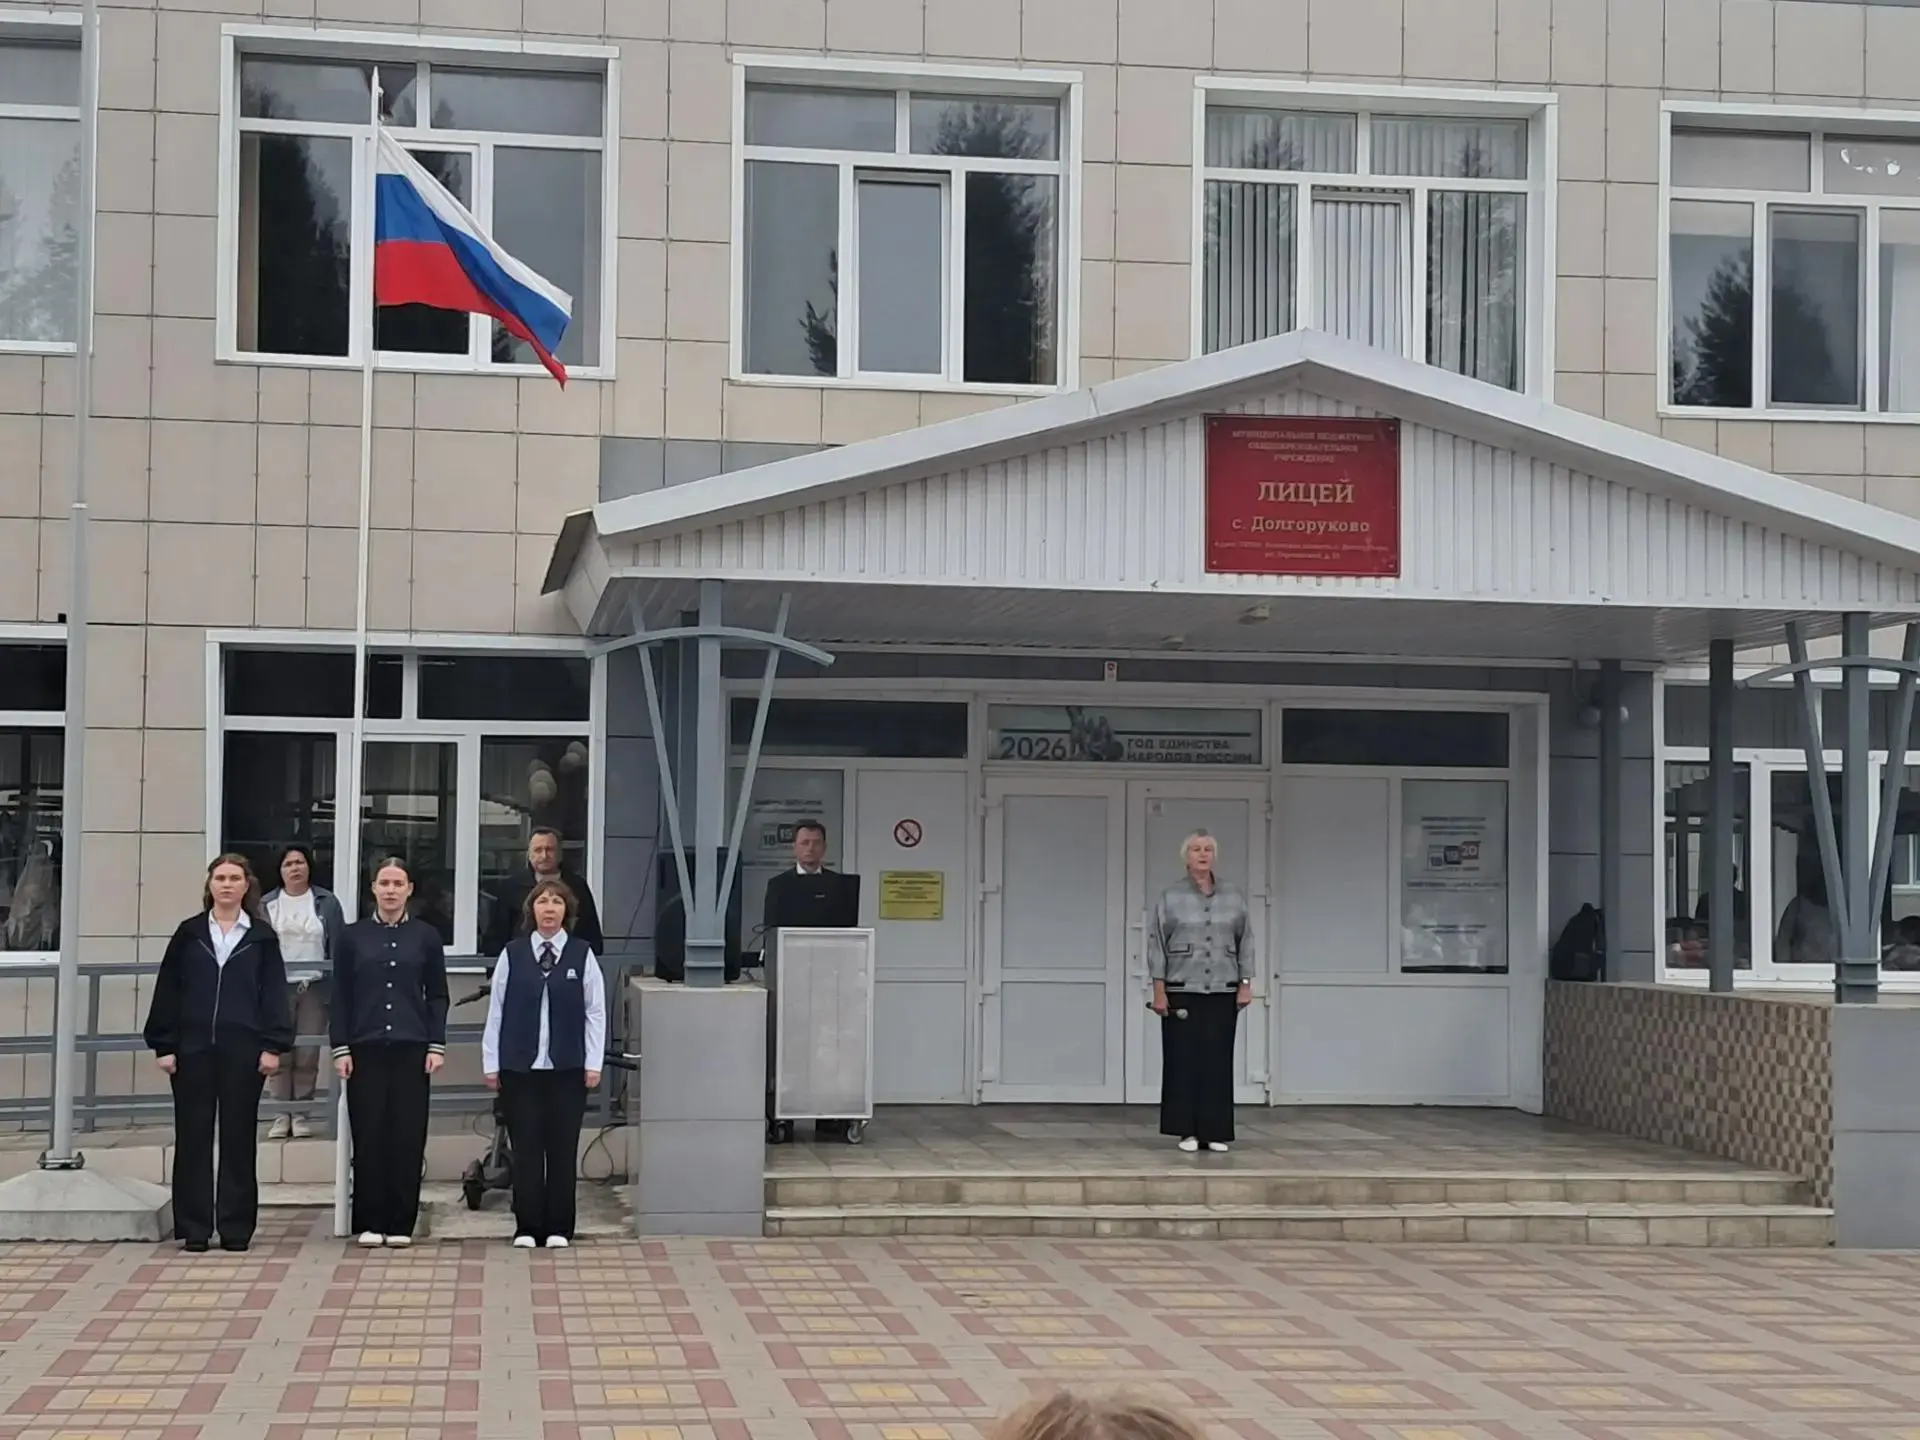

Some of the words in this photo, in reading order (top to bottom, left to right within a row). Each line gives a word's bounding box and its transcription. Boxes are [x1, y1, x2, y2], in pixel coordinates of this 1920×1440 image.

[1258, 478, 1355, 507] ЛИЦЕЙ
[1232, 518, 1246, 530] с.
[1251, 516, 1370, 535] Долгоруково
[1000, 736, 1067, 761] 2026
[1127, 738, 1154, 749] ГОД
[1159, 738, 1230, 750] ЕДИНСТВА
[1461, 845, 1478, 857] 20
